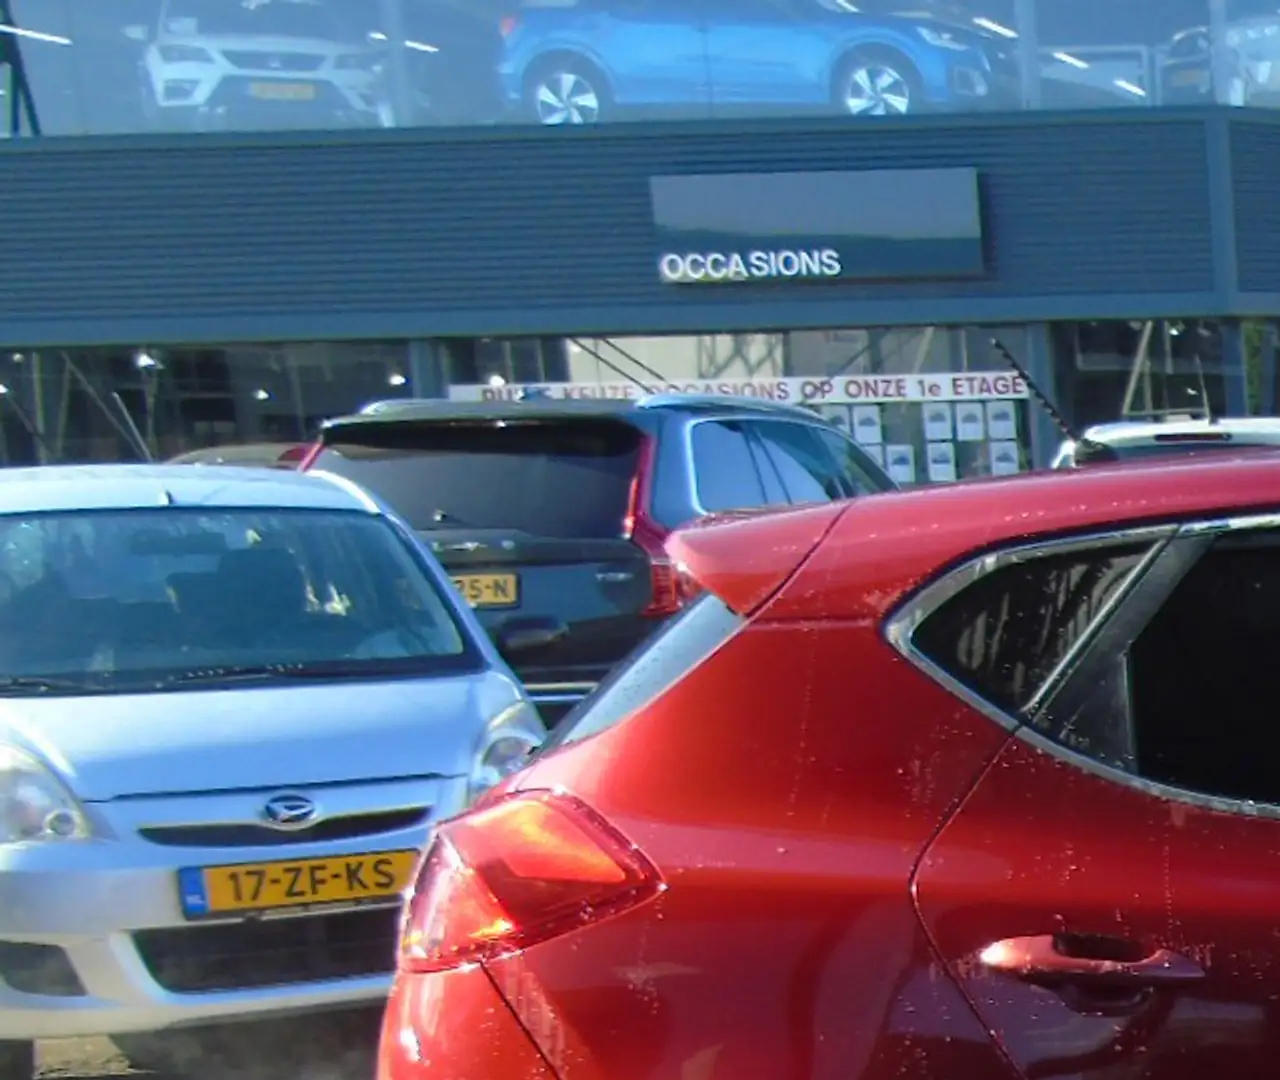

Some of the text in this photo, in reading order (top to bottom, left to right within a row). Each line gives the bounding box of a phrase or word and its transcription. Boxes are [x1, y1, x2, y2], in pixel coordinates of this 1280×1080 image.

[661, 250, 842, 279] OCCASIONS
[800, 379, 834, 399] OP
[844, 378, 907, 399] ONZE
[917, 378, 942, 398] 1e
[951, 375, 1025, 396] ETAGE
[228, 858, 396, 902] 17-ZF-KS
